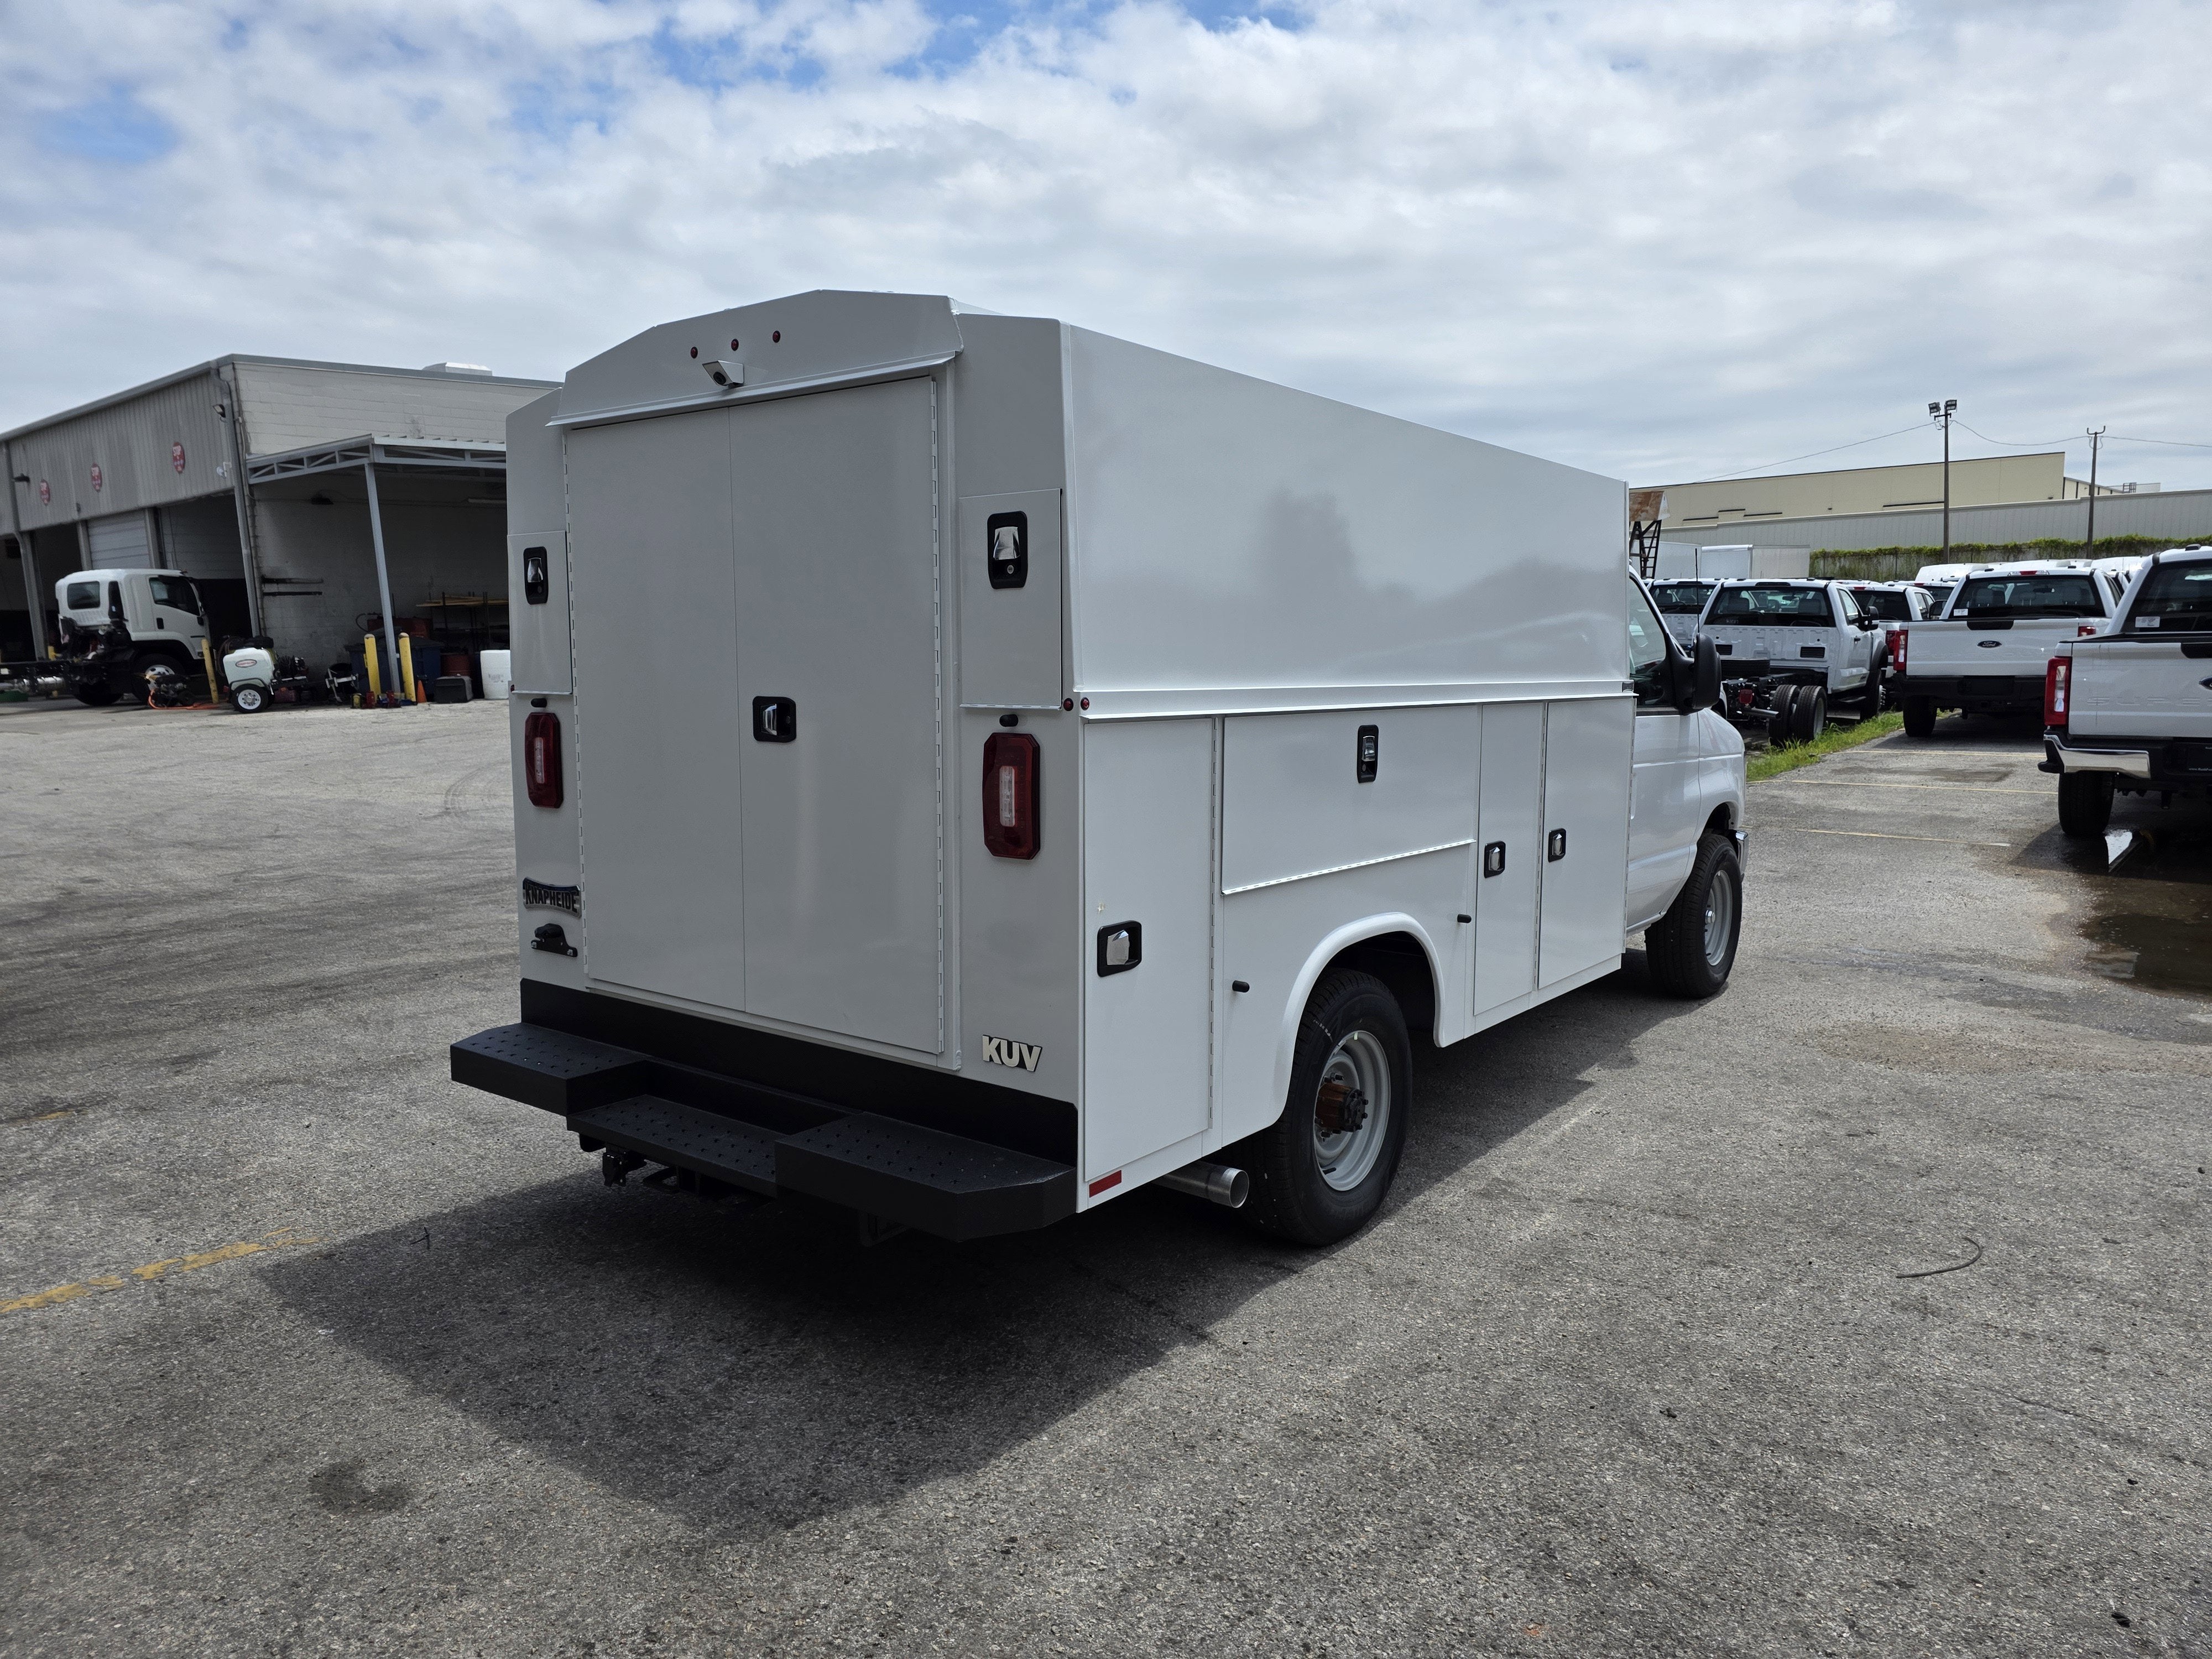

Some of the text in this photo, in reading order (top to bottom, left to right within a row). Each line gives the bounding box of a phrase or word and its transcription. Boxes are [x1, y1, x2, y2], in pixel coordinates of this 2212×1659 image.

[2087, 696, 2212, 707] SUPE
[525, 885, 580, 914] KNAPHEIDE
[982, 1035, 1042, 1072] KUV
